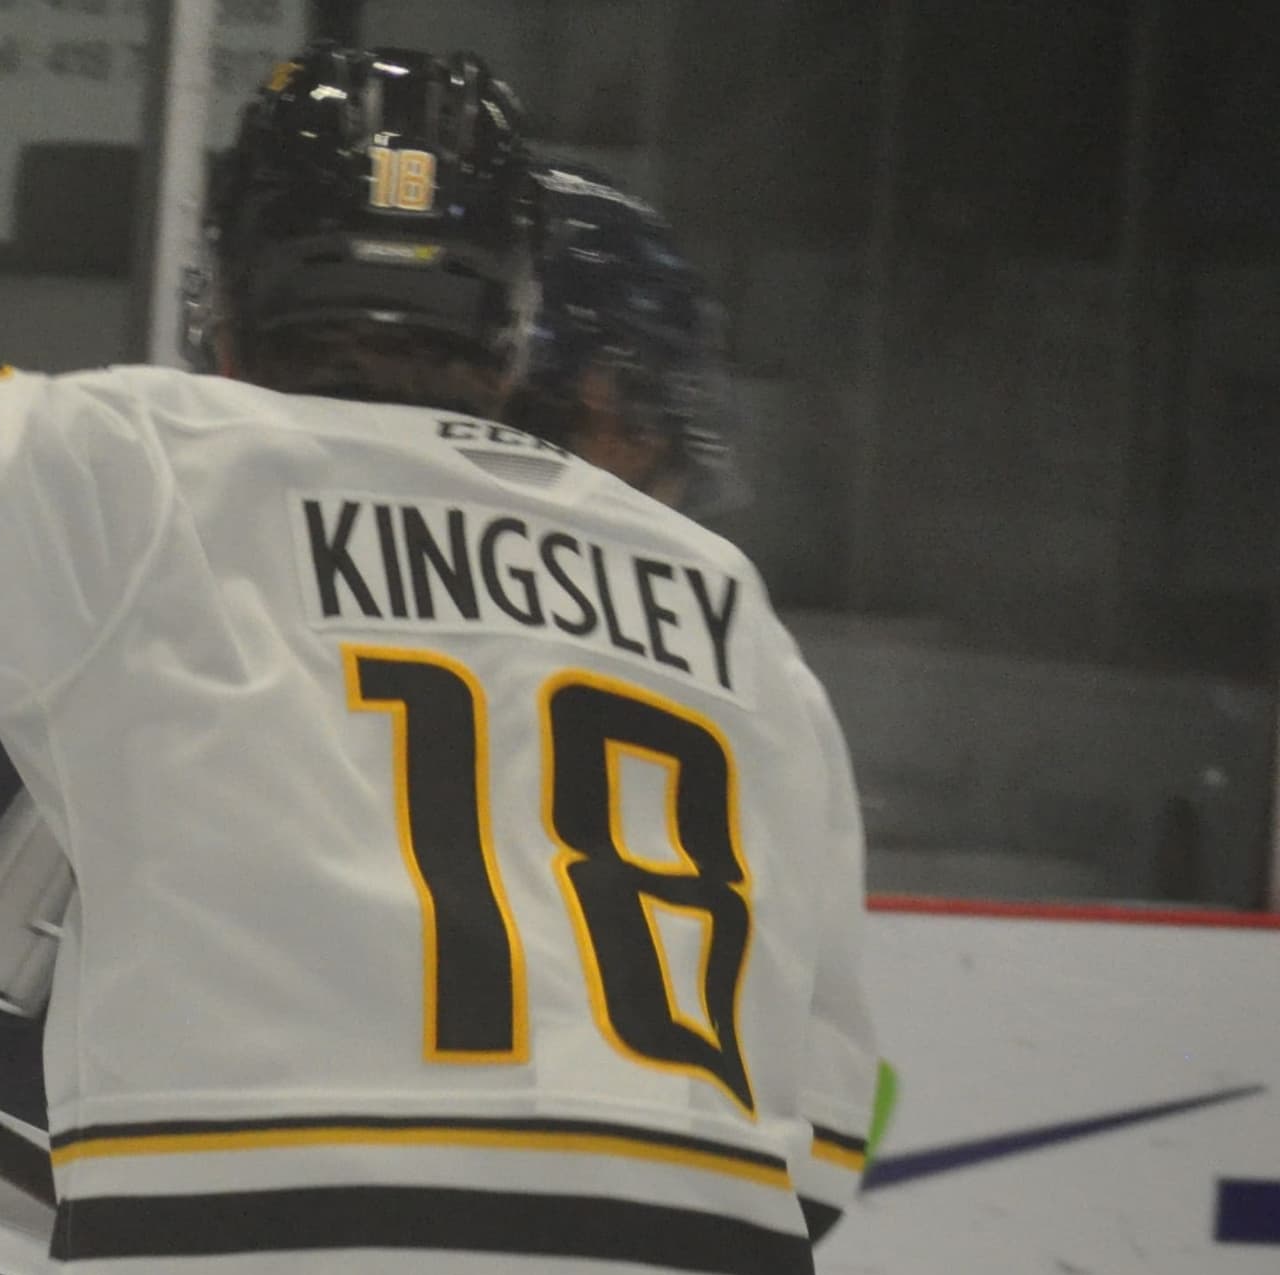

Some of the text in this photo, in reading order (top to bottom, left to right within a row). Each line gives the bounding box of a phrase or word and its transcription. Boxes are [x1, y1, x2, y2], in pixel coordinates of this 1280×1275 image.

[368, 148, 438, 211] 18
[302, 498, 740, 690] KINGSLEY
[342, 643, 758, 1123] 18
